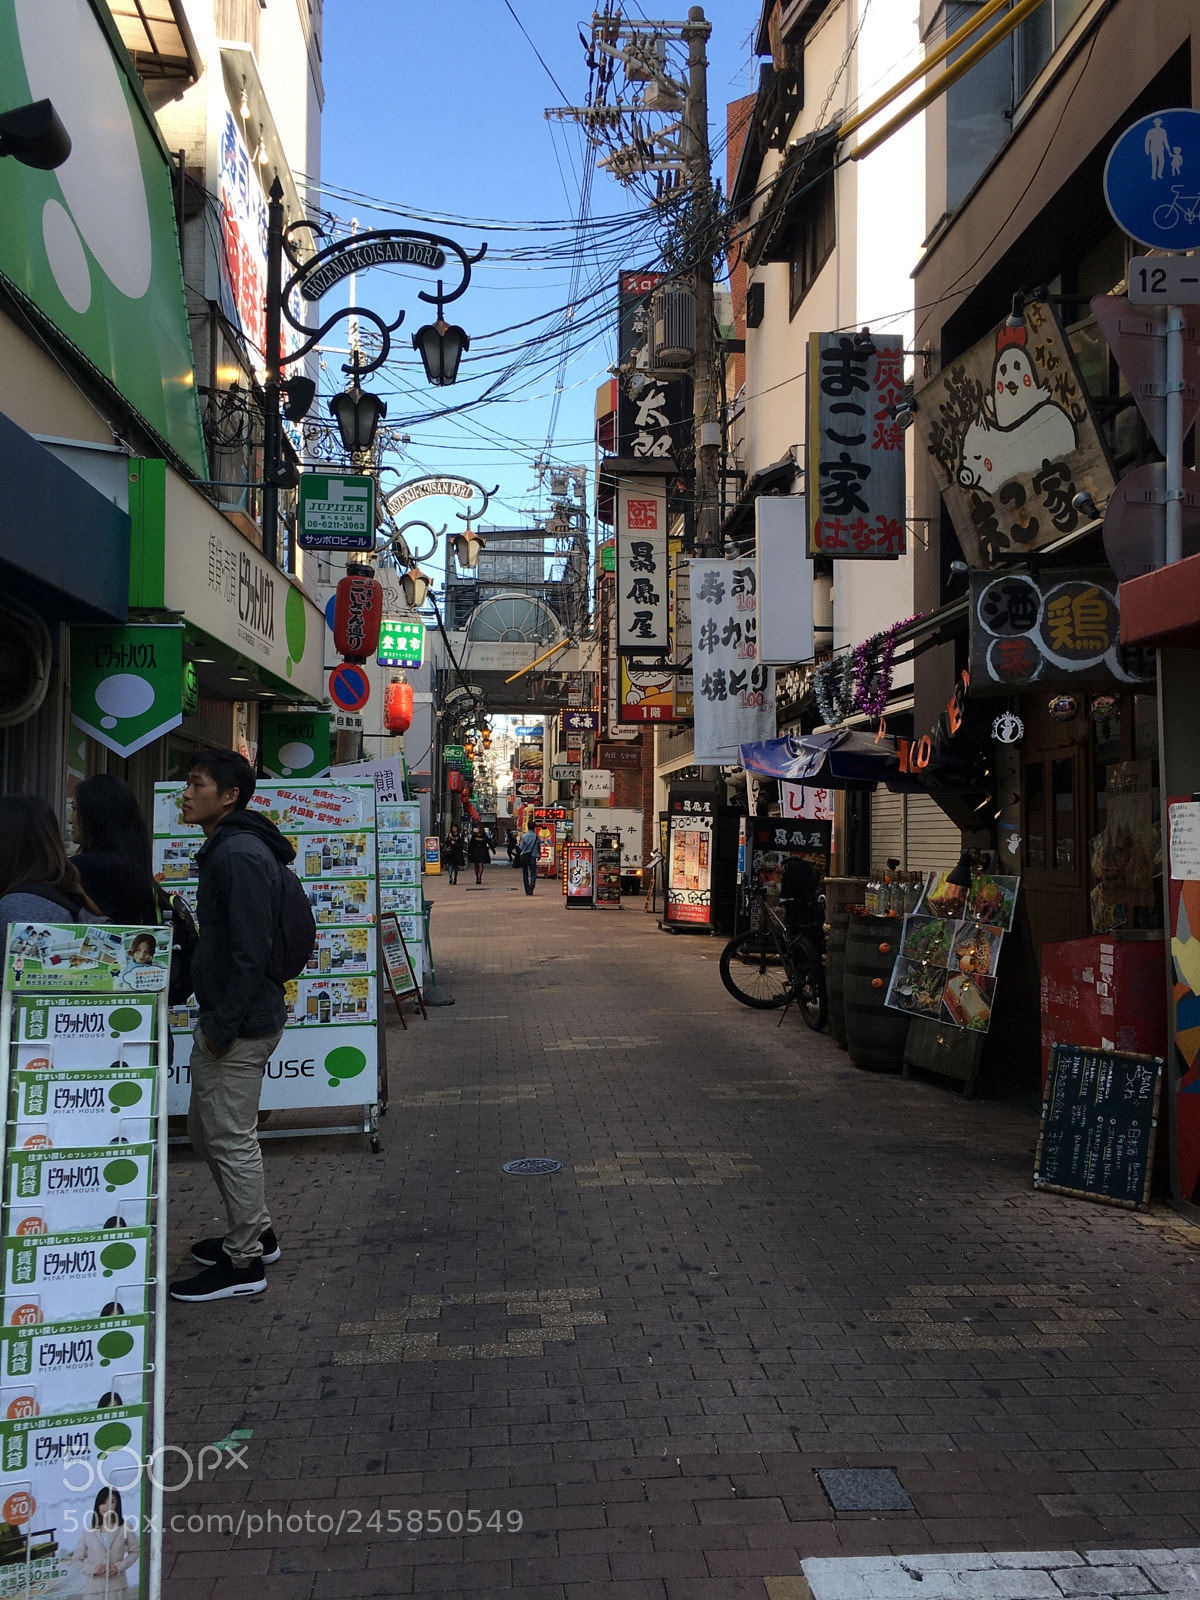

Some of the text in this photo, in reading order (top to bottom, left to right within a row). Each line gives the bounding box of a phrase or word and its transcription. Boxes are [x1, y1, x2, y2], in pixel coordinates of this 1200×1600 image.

[1138, 268, 1167, 293] 12
[1027, 302, 1080, 410] はなれ
[871, 346, 904, 451] 炭火焼
[818, 337, 872, 516] まこ家
[308, 502, 365, 513] JUPITER
[304, 534, 367, 547] サッポロビール
[814, 514, 906, 553] はなれ
[238, 550, 275, 642] ピタットハウス
[984, 584, 1038, 630] 酒
[347, 579, 365, 650] こいさん通り
[1047, 586, 1110, 651] 鶏
[95, 643, 158, 669] ピタットハウス
[997, 638, 1032, 678] 菜
[336, 716, 363, 728] 自動車
[641, 706, 662, 720] 1階
[278, 723, 316, 740] ピタットハウス
[312, 788, 354, 804] 新規オープン
[572, 850, 582, 886] ラーメン
[29, 1009, 44, 1037] 賃貸
[54, 1012, 105, 1034] ピタットハウス
[27, 1084, 44, 1113] 賃貸
[54, 1087, 105, 1109] ピタットハウス
[21, 1165, 37, 1195] 賃貸
[48, 1165, 100, 1191] ピタットハウス
[16, 1250, 32, 1282] 賃貸
[43, 1250, 97, 1276] ピタットハウス
[69, 1272, 97, 1280] HOUSE
[12, 1340, 28, 1373] 賃貸
[39, 1339, 94, 1367] ピタットハウス
[66, 1362, 94, 1370] HOUSE
[6, 1435, 24, 1469] 賃貸
[35, 1431, 92, 1460] ピタットハウス
[34, 1459, 59, 1467] PITAT
[9, 1501, 29, 1516] ¥0
